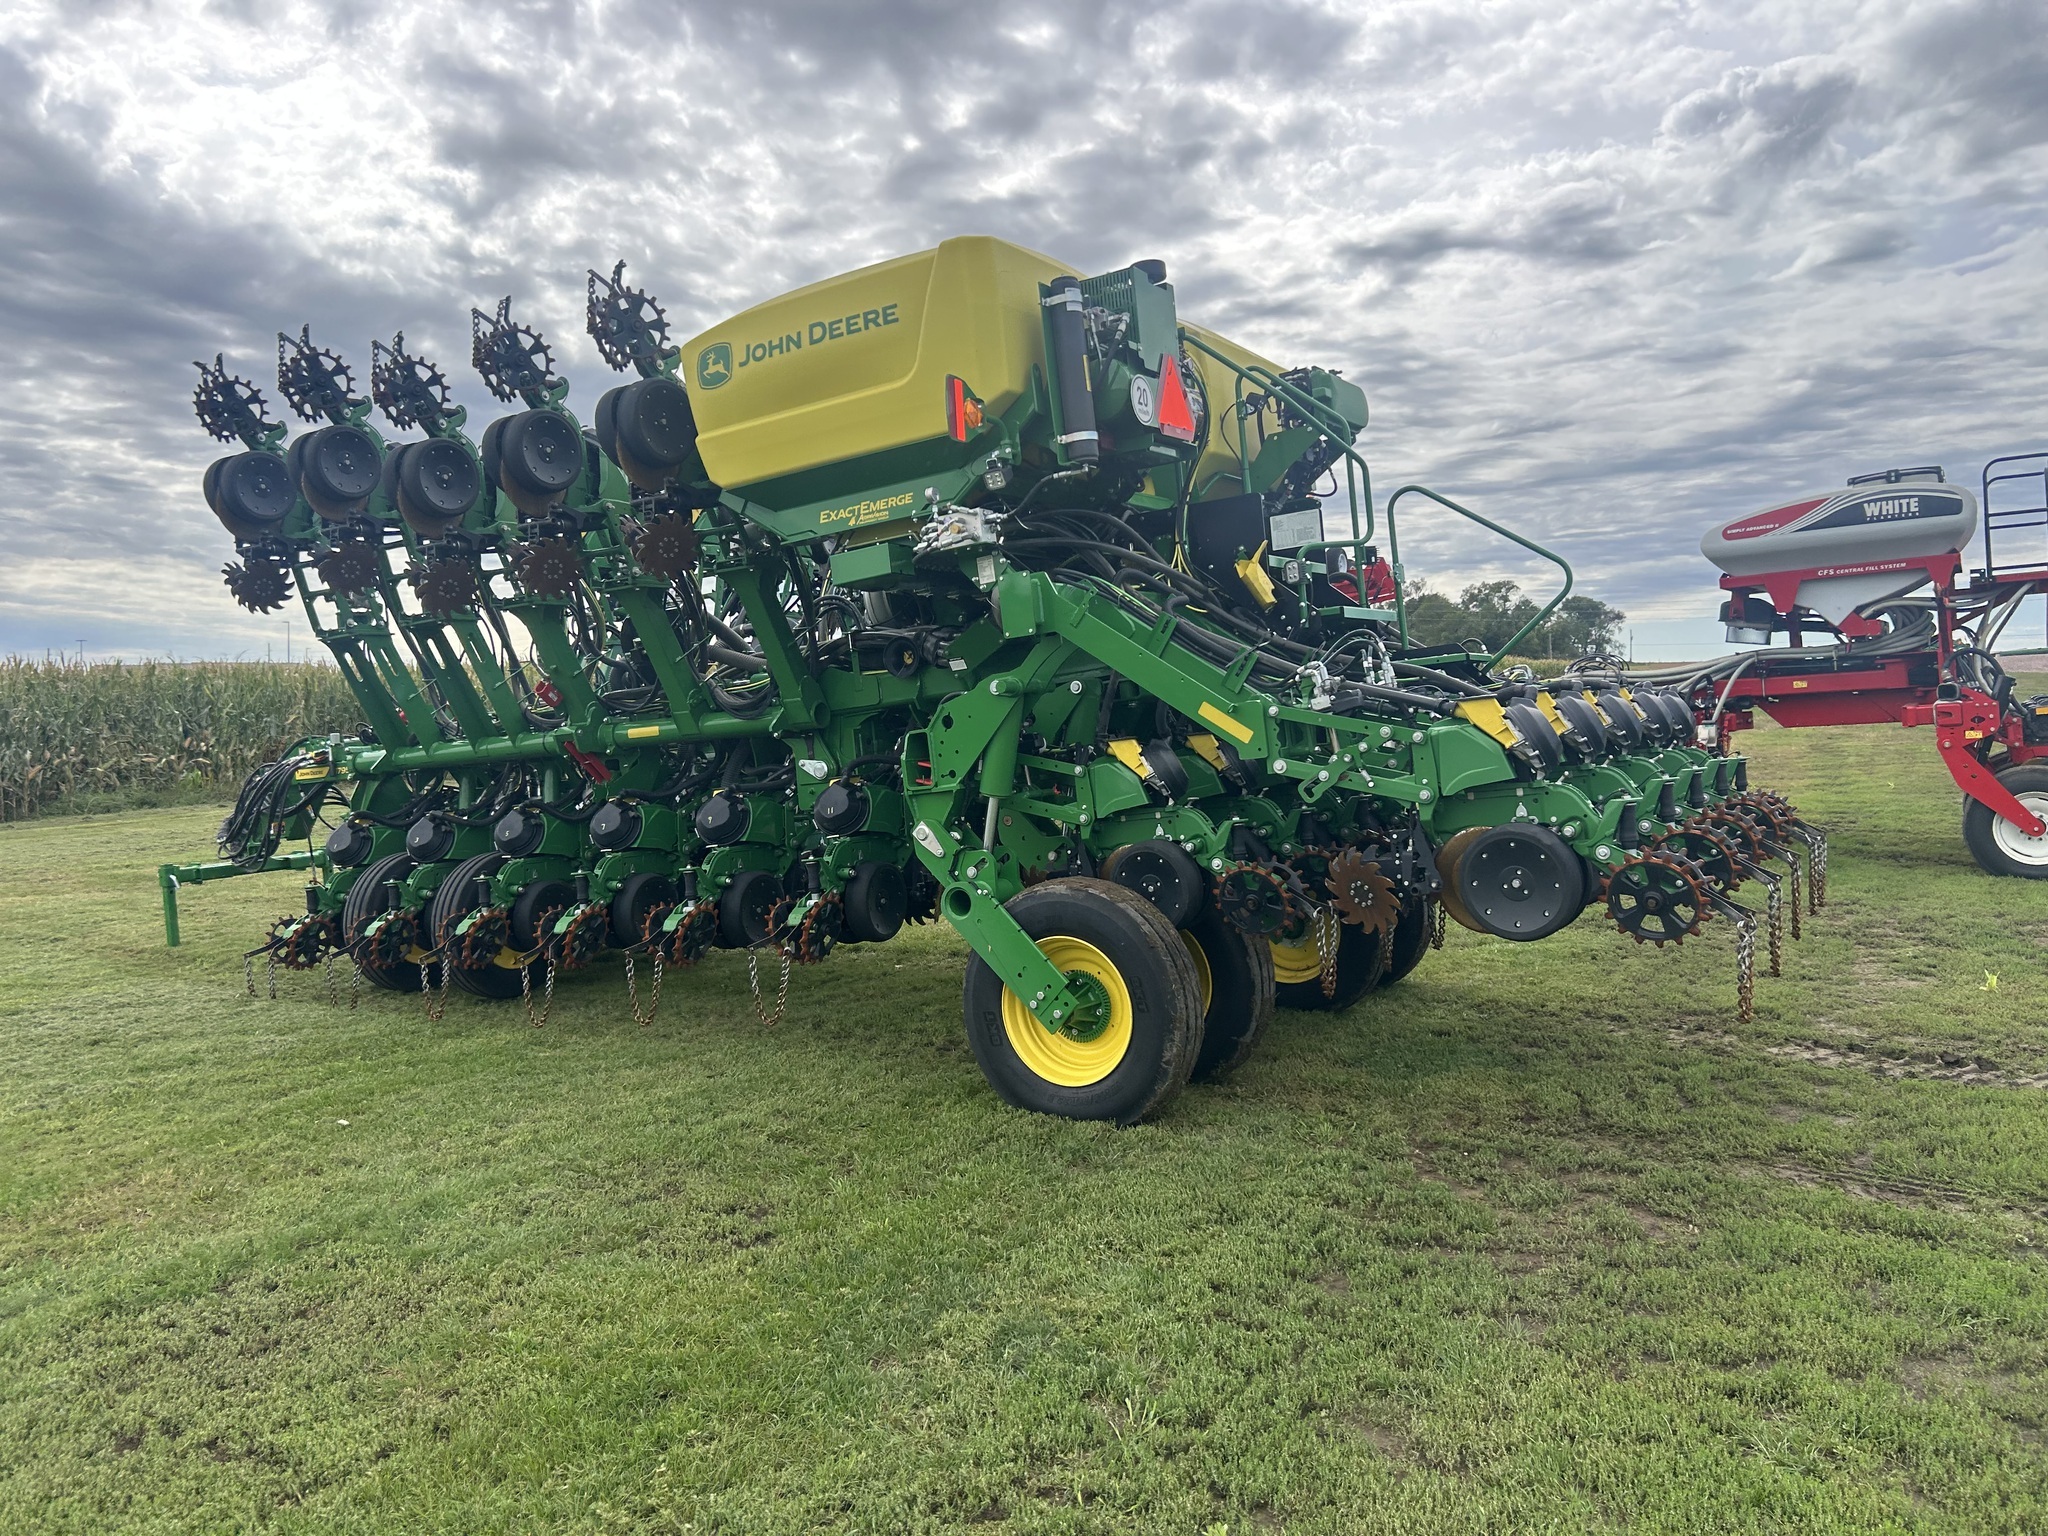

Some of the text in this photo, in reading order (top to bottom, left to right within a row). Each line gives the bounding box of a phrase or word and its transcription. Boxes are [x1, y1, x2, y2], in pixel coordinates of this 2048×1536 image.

[738, 303, 899, 367] JOHN DEERE
[1136, 386, 1149, 408] 20
[1863, 497, 1919, 517] WHITE
[1817, 568, 1835, 576] CFS
[1880, 562, 1907, 570] SYSTEM
[1129, 975, 1149, 1013] BKT
[983, 1010, 1003, 1047] BKT
